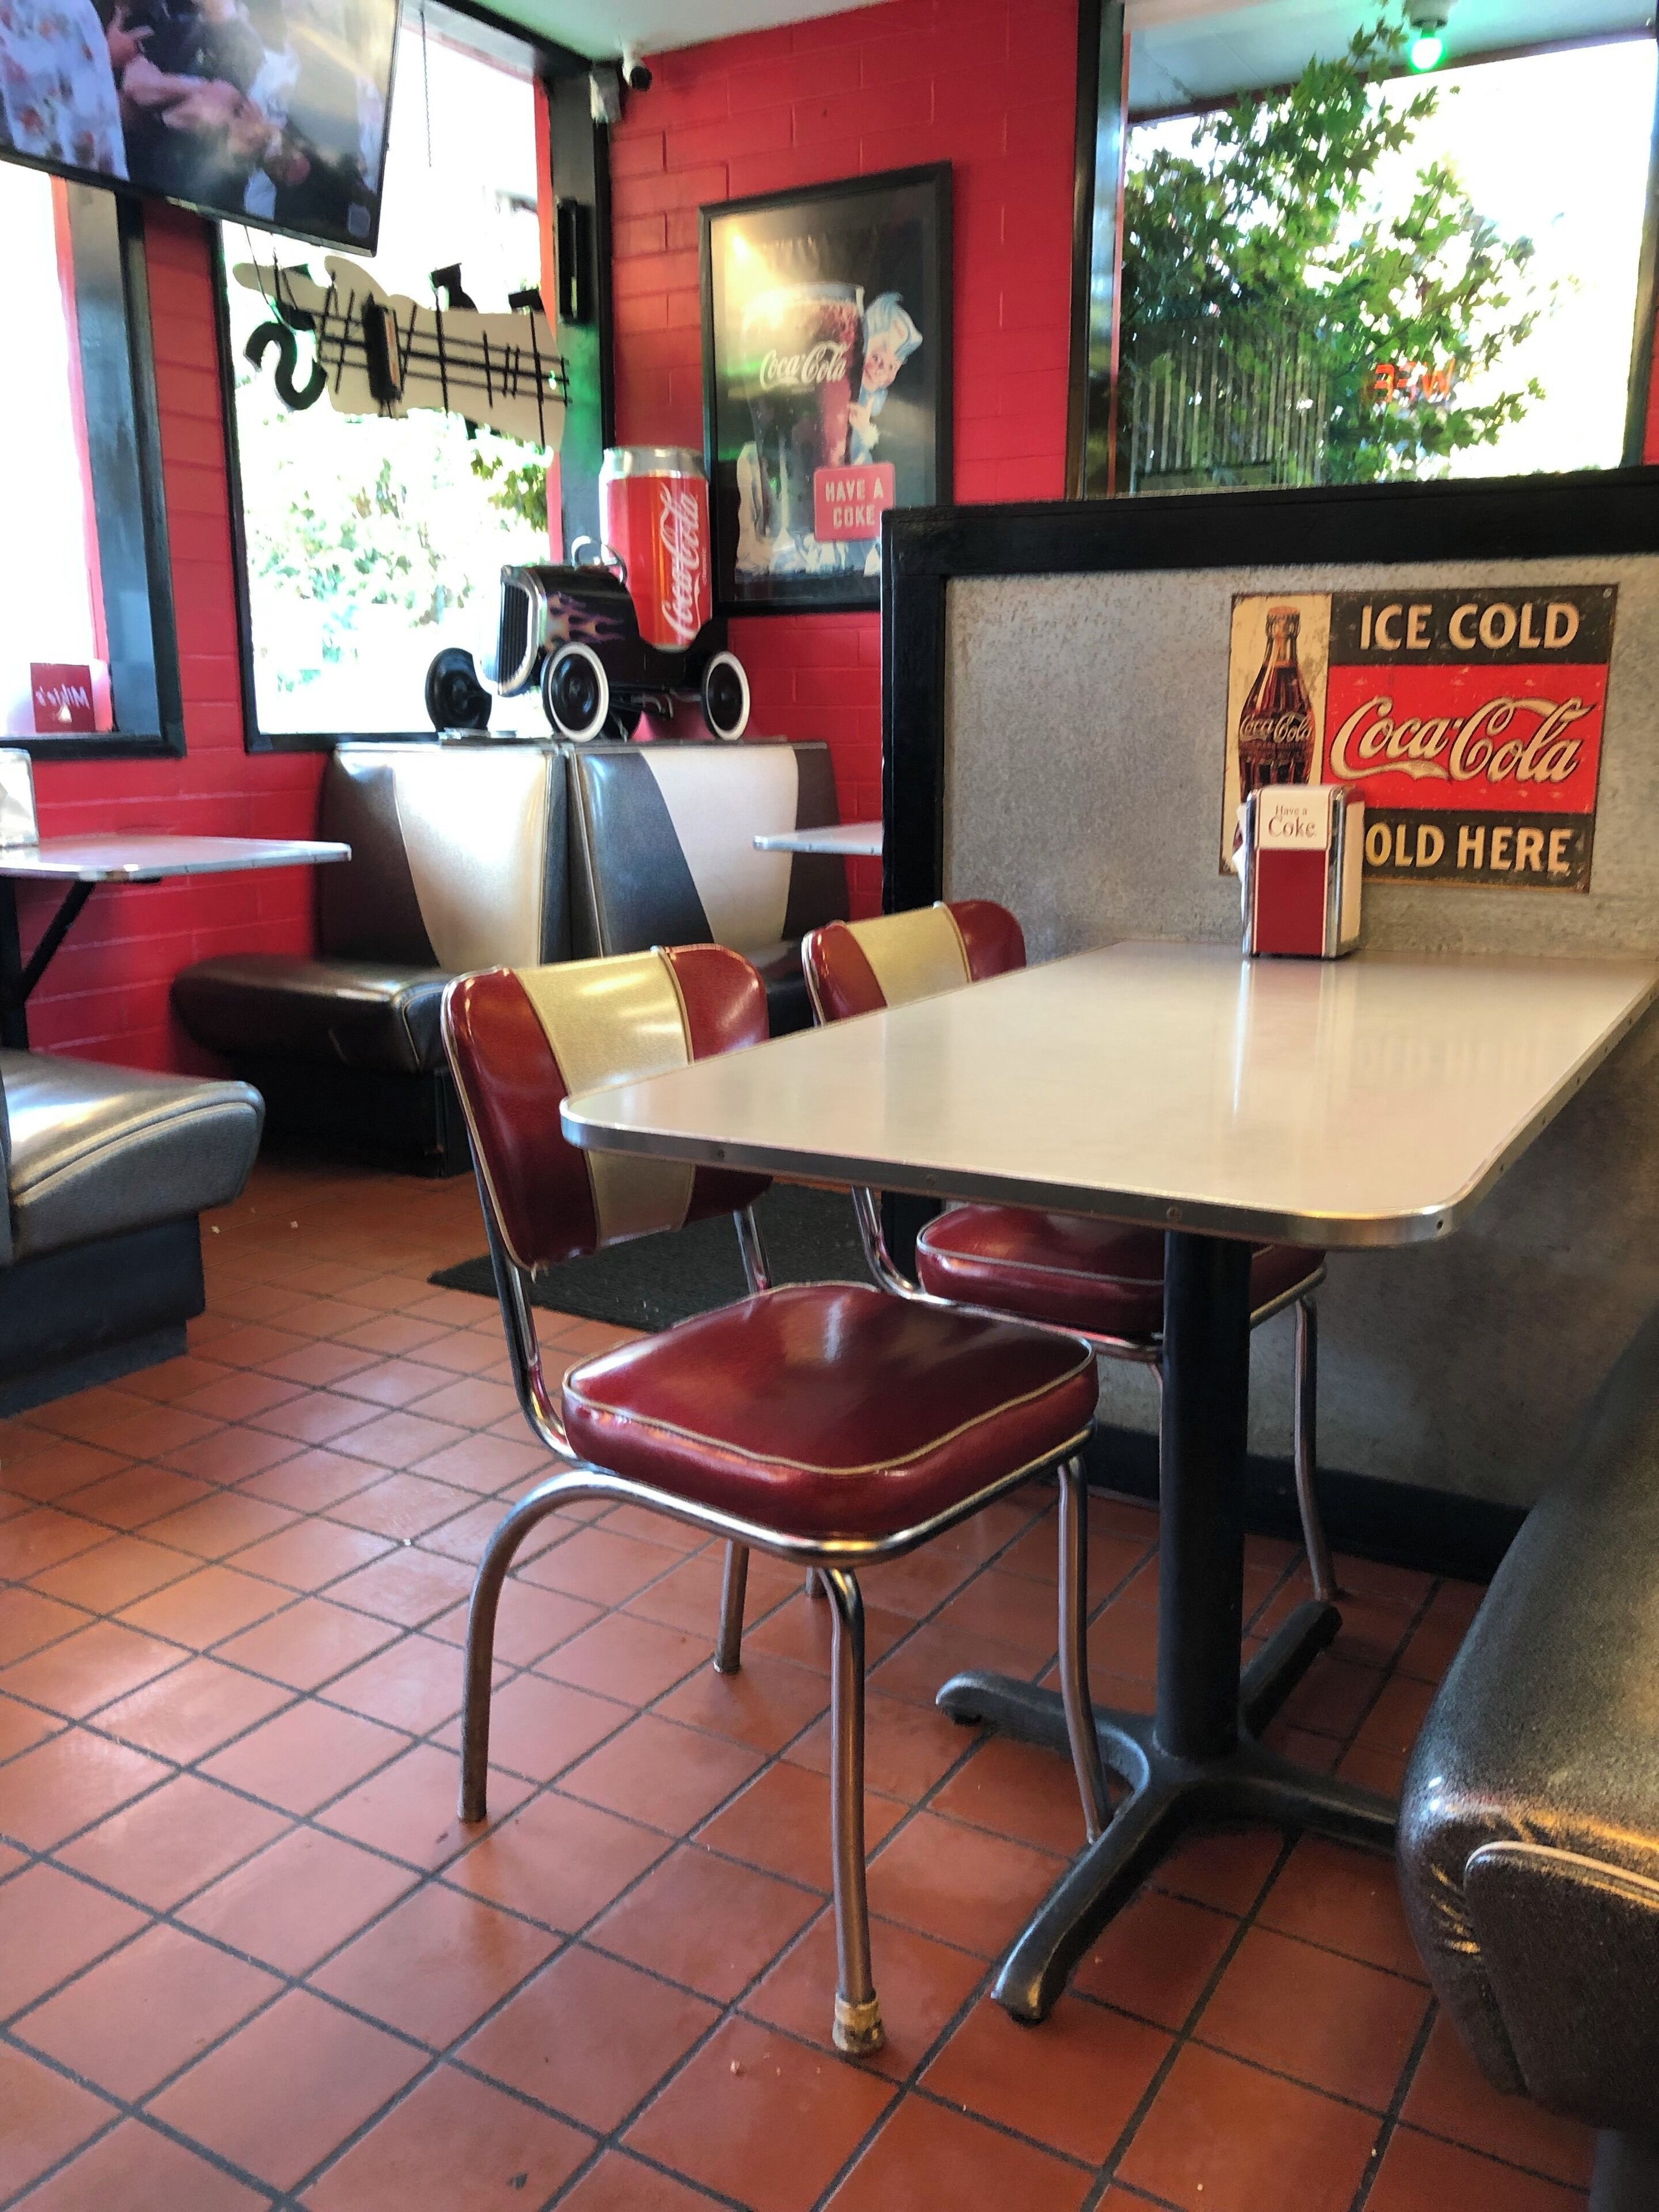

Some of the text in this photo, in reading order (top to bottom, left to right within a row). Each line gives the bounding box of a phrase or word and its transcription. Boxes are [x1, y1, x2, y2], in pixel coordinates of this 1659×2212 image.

[759, 339, 853, 389] Coca-Cola
[825, 477, 884, 503] HAVE A
[833, 504, 875, 529] COKE
[1360, 602, 1580, 650] ICE COLD
[1330, 695, 1597, 783] Coca-Cola
[1268, 815, 1316, 838] Coke
[1275, 804, 1308, 816] Have a
[1365, 821, 1573, 876] OLD HERE
